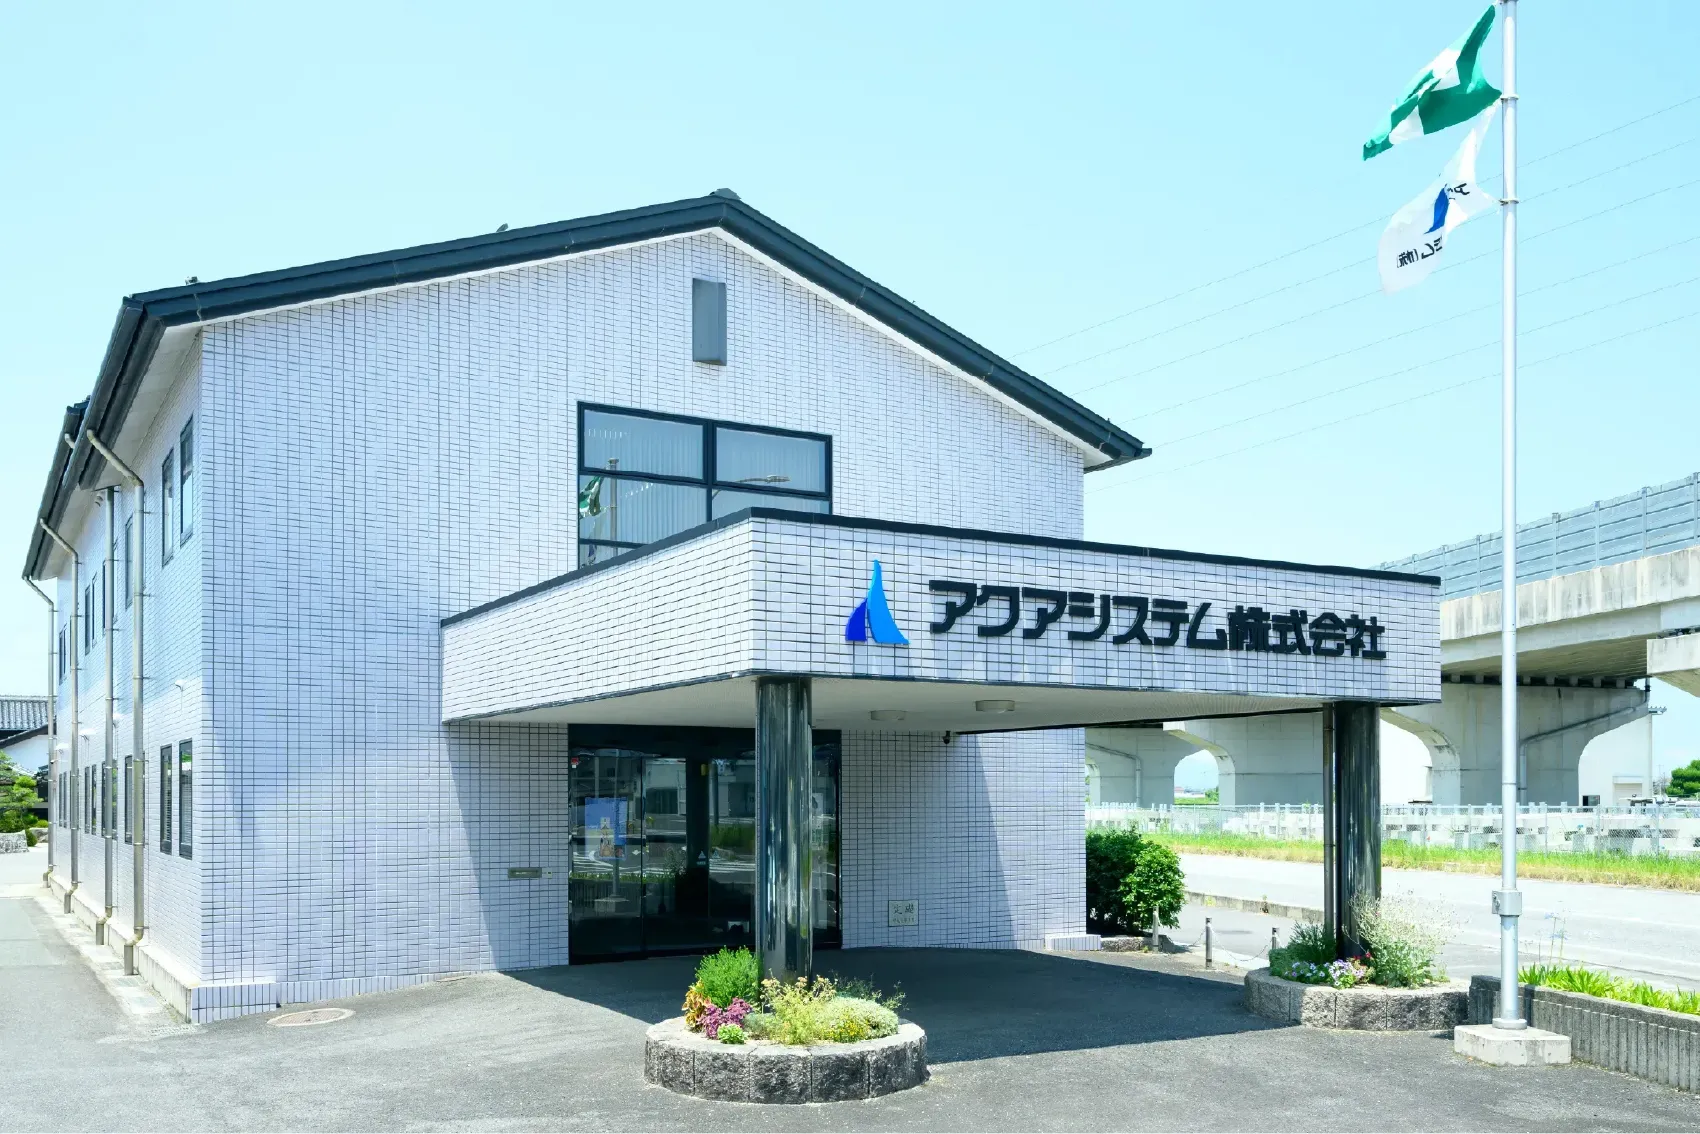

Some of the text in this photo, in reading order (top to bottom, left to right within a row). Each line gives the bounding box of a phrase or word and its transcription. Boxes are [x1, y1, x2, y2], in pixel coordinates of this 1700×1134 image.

[929, 579, 1387, 659] アクアシステム株式会社
